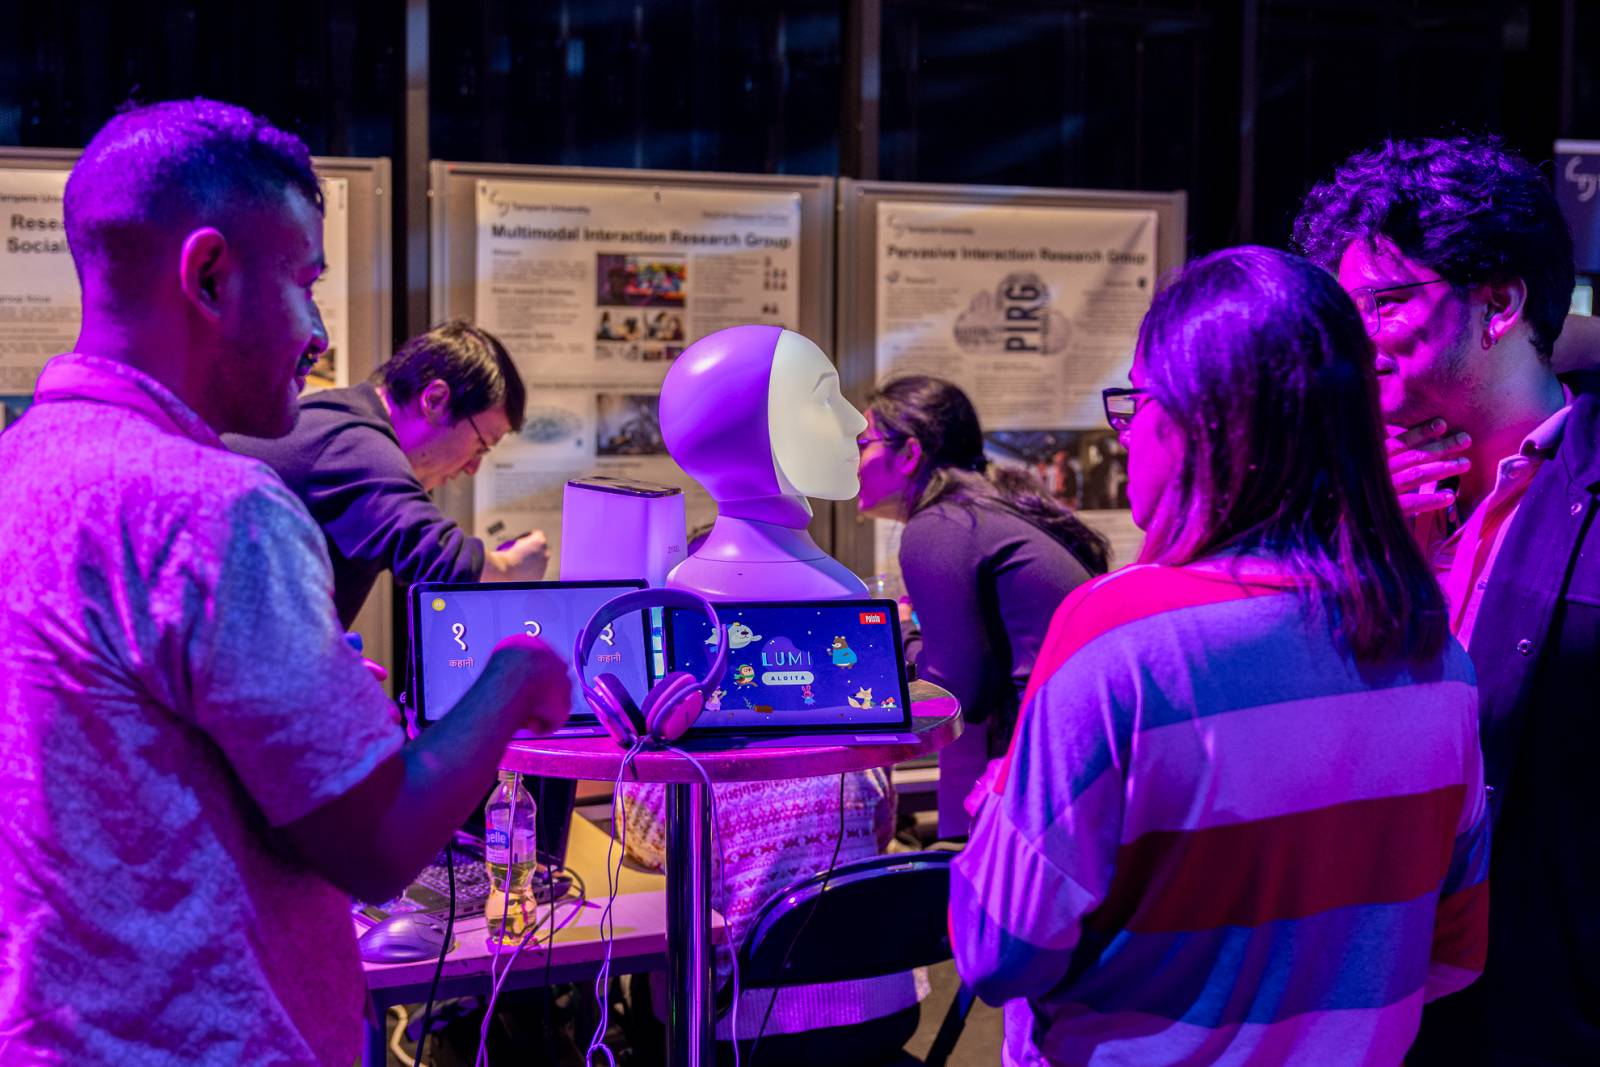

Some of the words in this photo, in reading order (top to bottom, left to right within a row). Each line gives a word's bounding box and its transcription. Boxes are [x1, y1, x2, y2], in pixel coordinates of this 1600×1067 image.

[491, 224, 580, 241] Multimodal
[584, 227, 667, 244] Interaction
[670, 230, 741, 246] Research
[745, 233, 791, 249] Group
[886, 244, 957, 259] Pervasive
[960, 247, 1035, 261] Interaction
[1040, 248, 1101, 262] Research
[1107, 249, 1146, 266] Group
[1005, 284, 1040, 351] PIRG
[452, 622, 466, 651] १
[448, 656, 474, 669] कहानी
[597, 651, 621, 664] कहानी
[761, 651, 811, 666] LUMI
